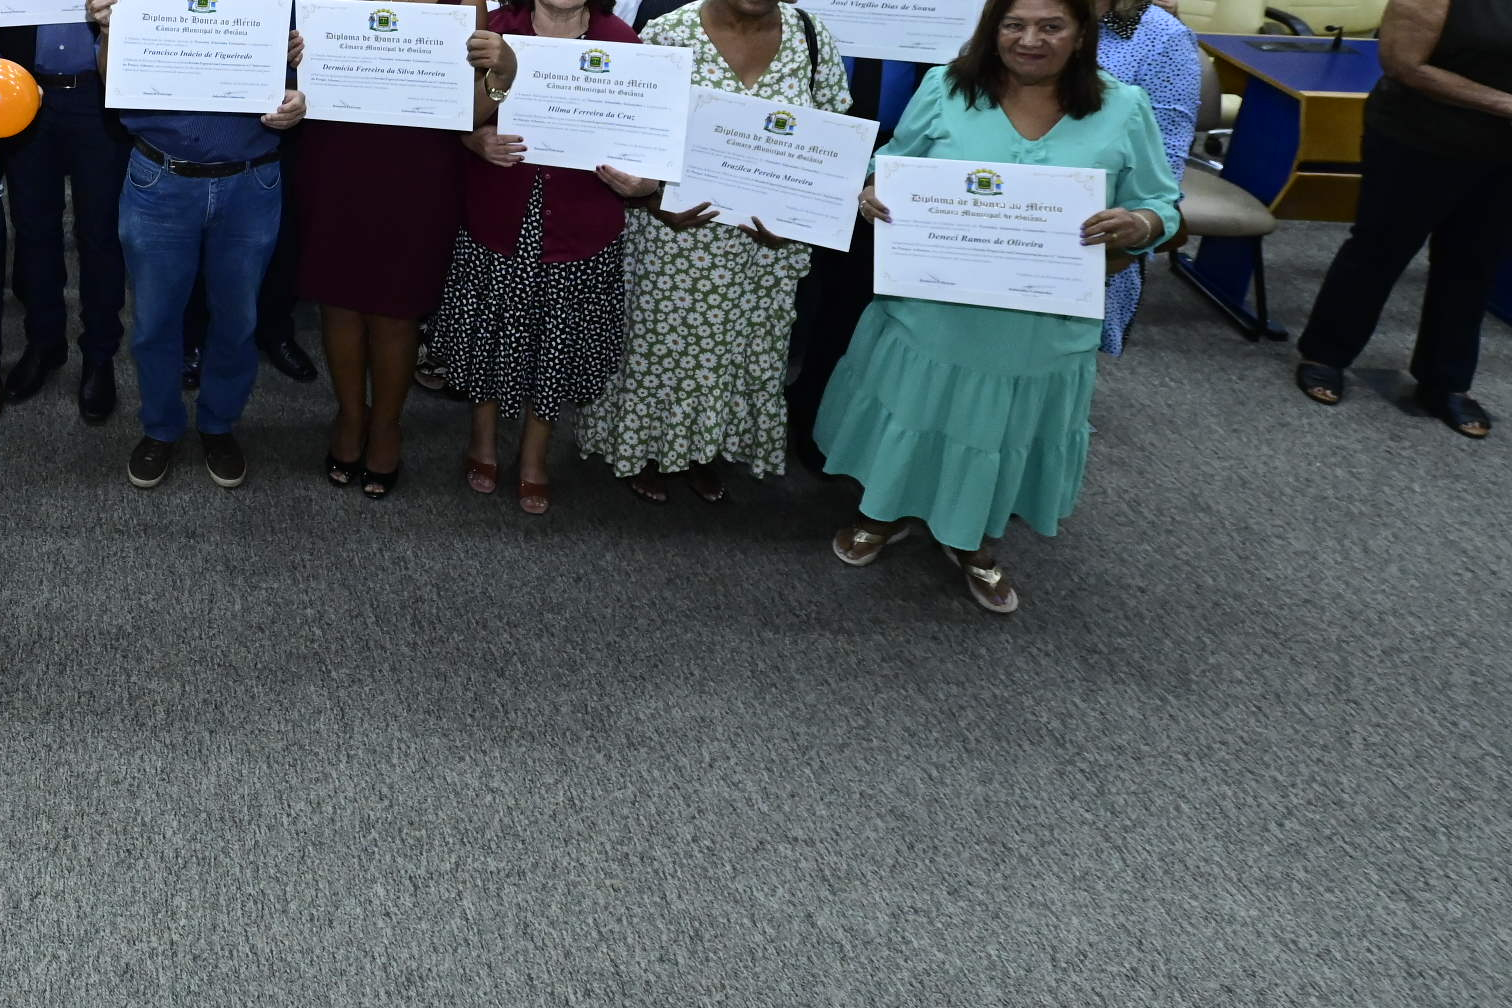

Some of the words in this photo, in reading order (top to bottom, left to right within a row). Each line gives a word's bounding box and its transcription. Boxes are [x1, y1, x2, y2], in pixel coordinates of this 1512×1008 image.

[142, 13, 177, 23] Diploma
[326, 32, 360, 41] Diploma
[144, 48, 178, 56] Francisco
[215, 52, 253, 60] Figueiredo
[356, 65, 384, 73] Ferreira
[416, 69, 445, 77] Moreira
[533, 71, 568, 81] Diploma
[548, 106, 570, 114] Hilma
[573, 108, 604, 117] Ferreira
[606, 110, 615, 118] da
[617, 112, 636, 121] Cruz
[713, 125, 751, 140] Diploma
[753, 133, 763, 141] de
[753, 168, 780, 179] Pereira
[782, 175, 813, 186] Moreira
[912, 194, 953, 204] Diploma
[961, 235, 992, 244] Ramos
[994, 237, 1005, 245] de
[1007, 238, 1044, 248] Oliveira
